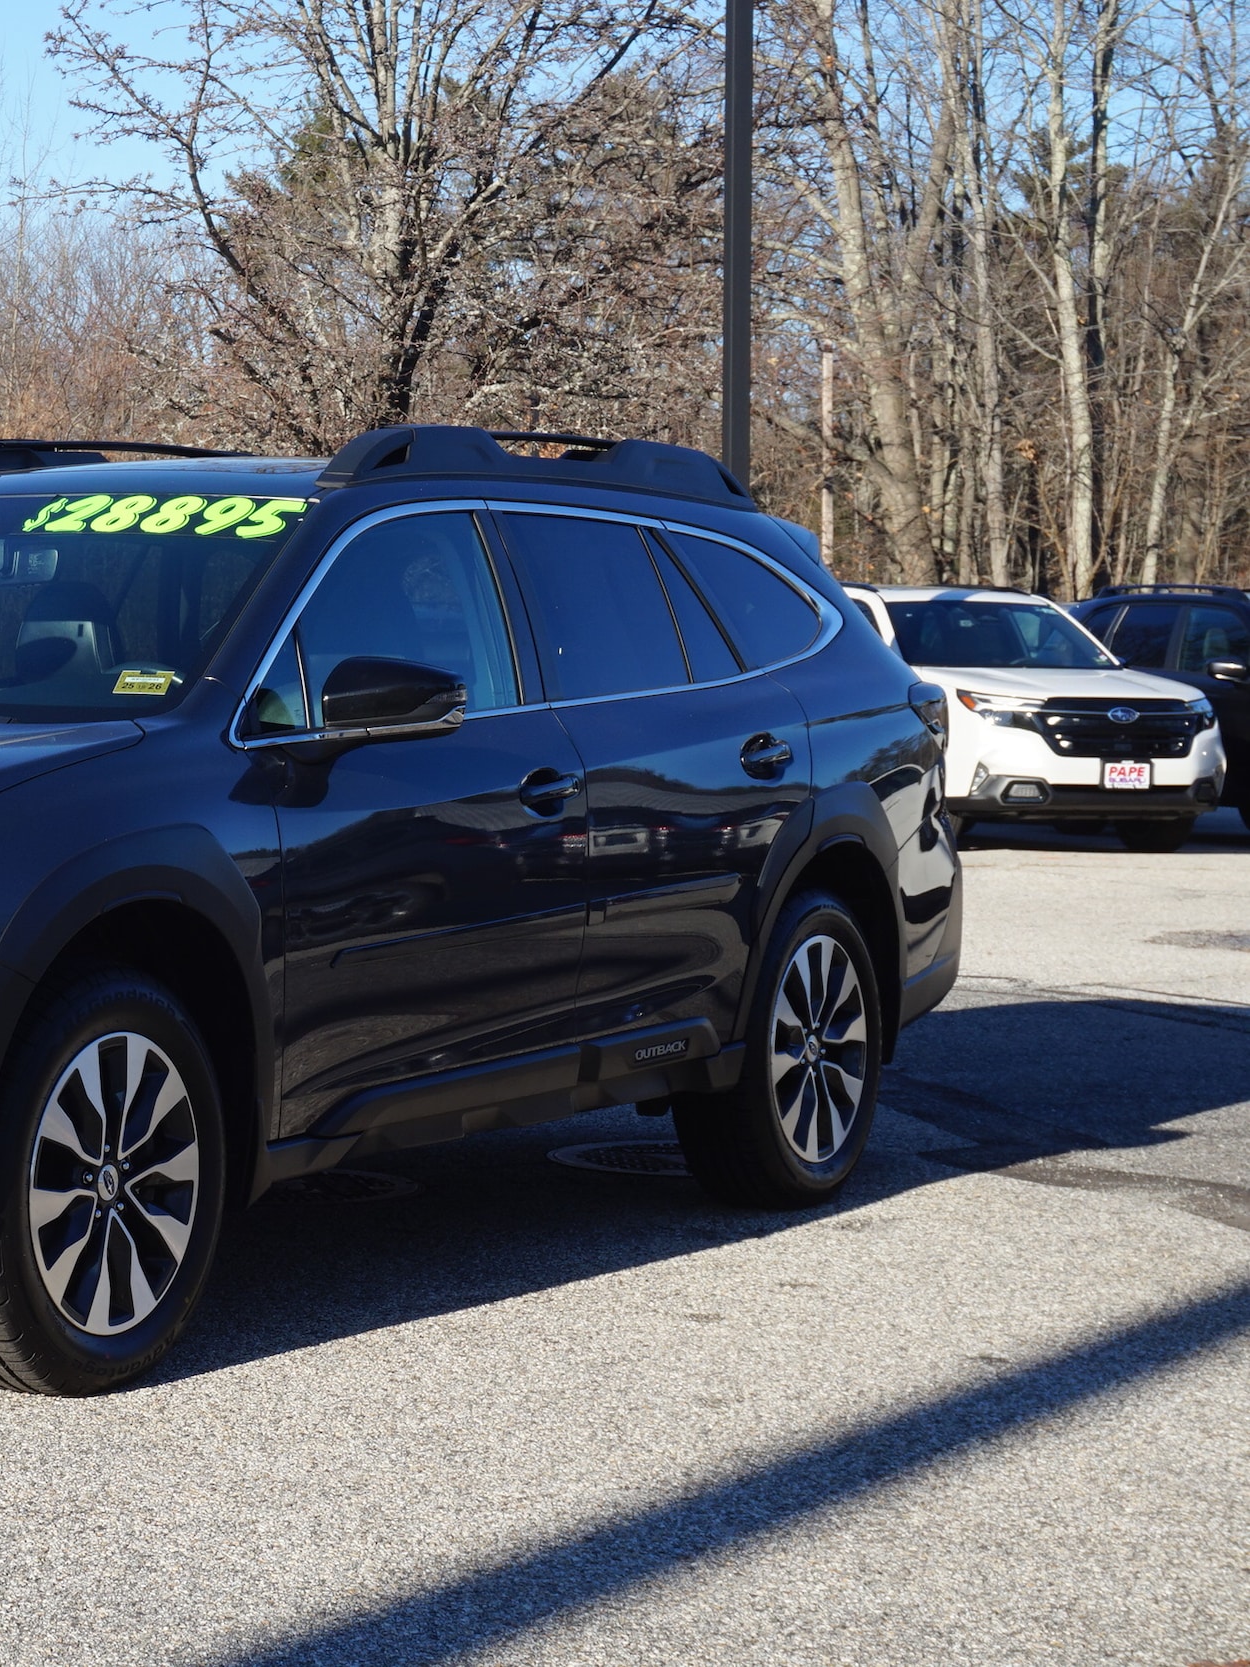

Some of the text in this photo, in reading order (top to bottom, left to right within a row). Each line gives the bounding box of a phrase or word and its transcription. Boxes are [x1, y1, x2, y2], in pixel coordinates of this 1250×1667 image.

[22, 495, 307, 538] $28895
[1109, 766, 1146, 777] PAPE
[635, 1040, 686, 1061] OUTBACK
